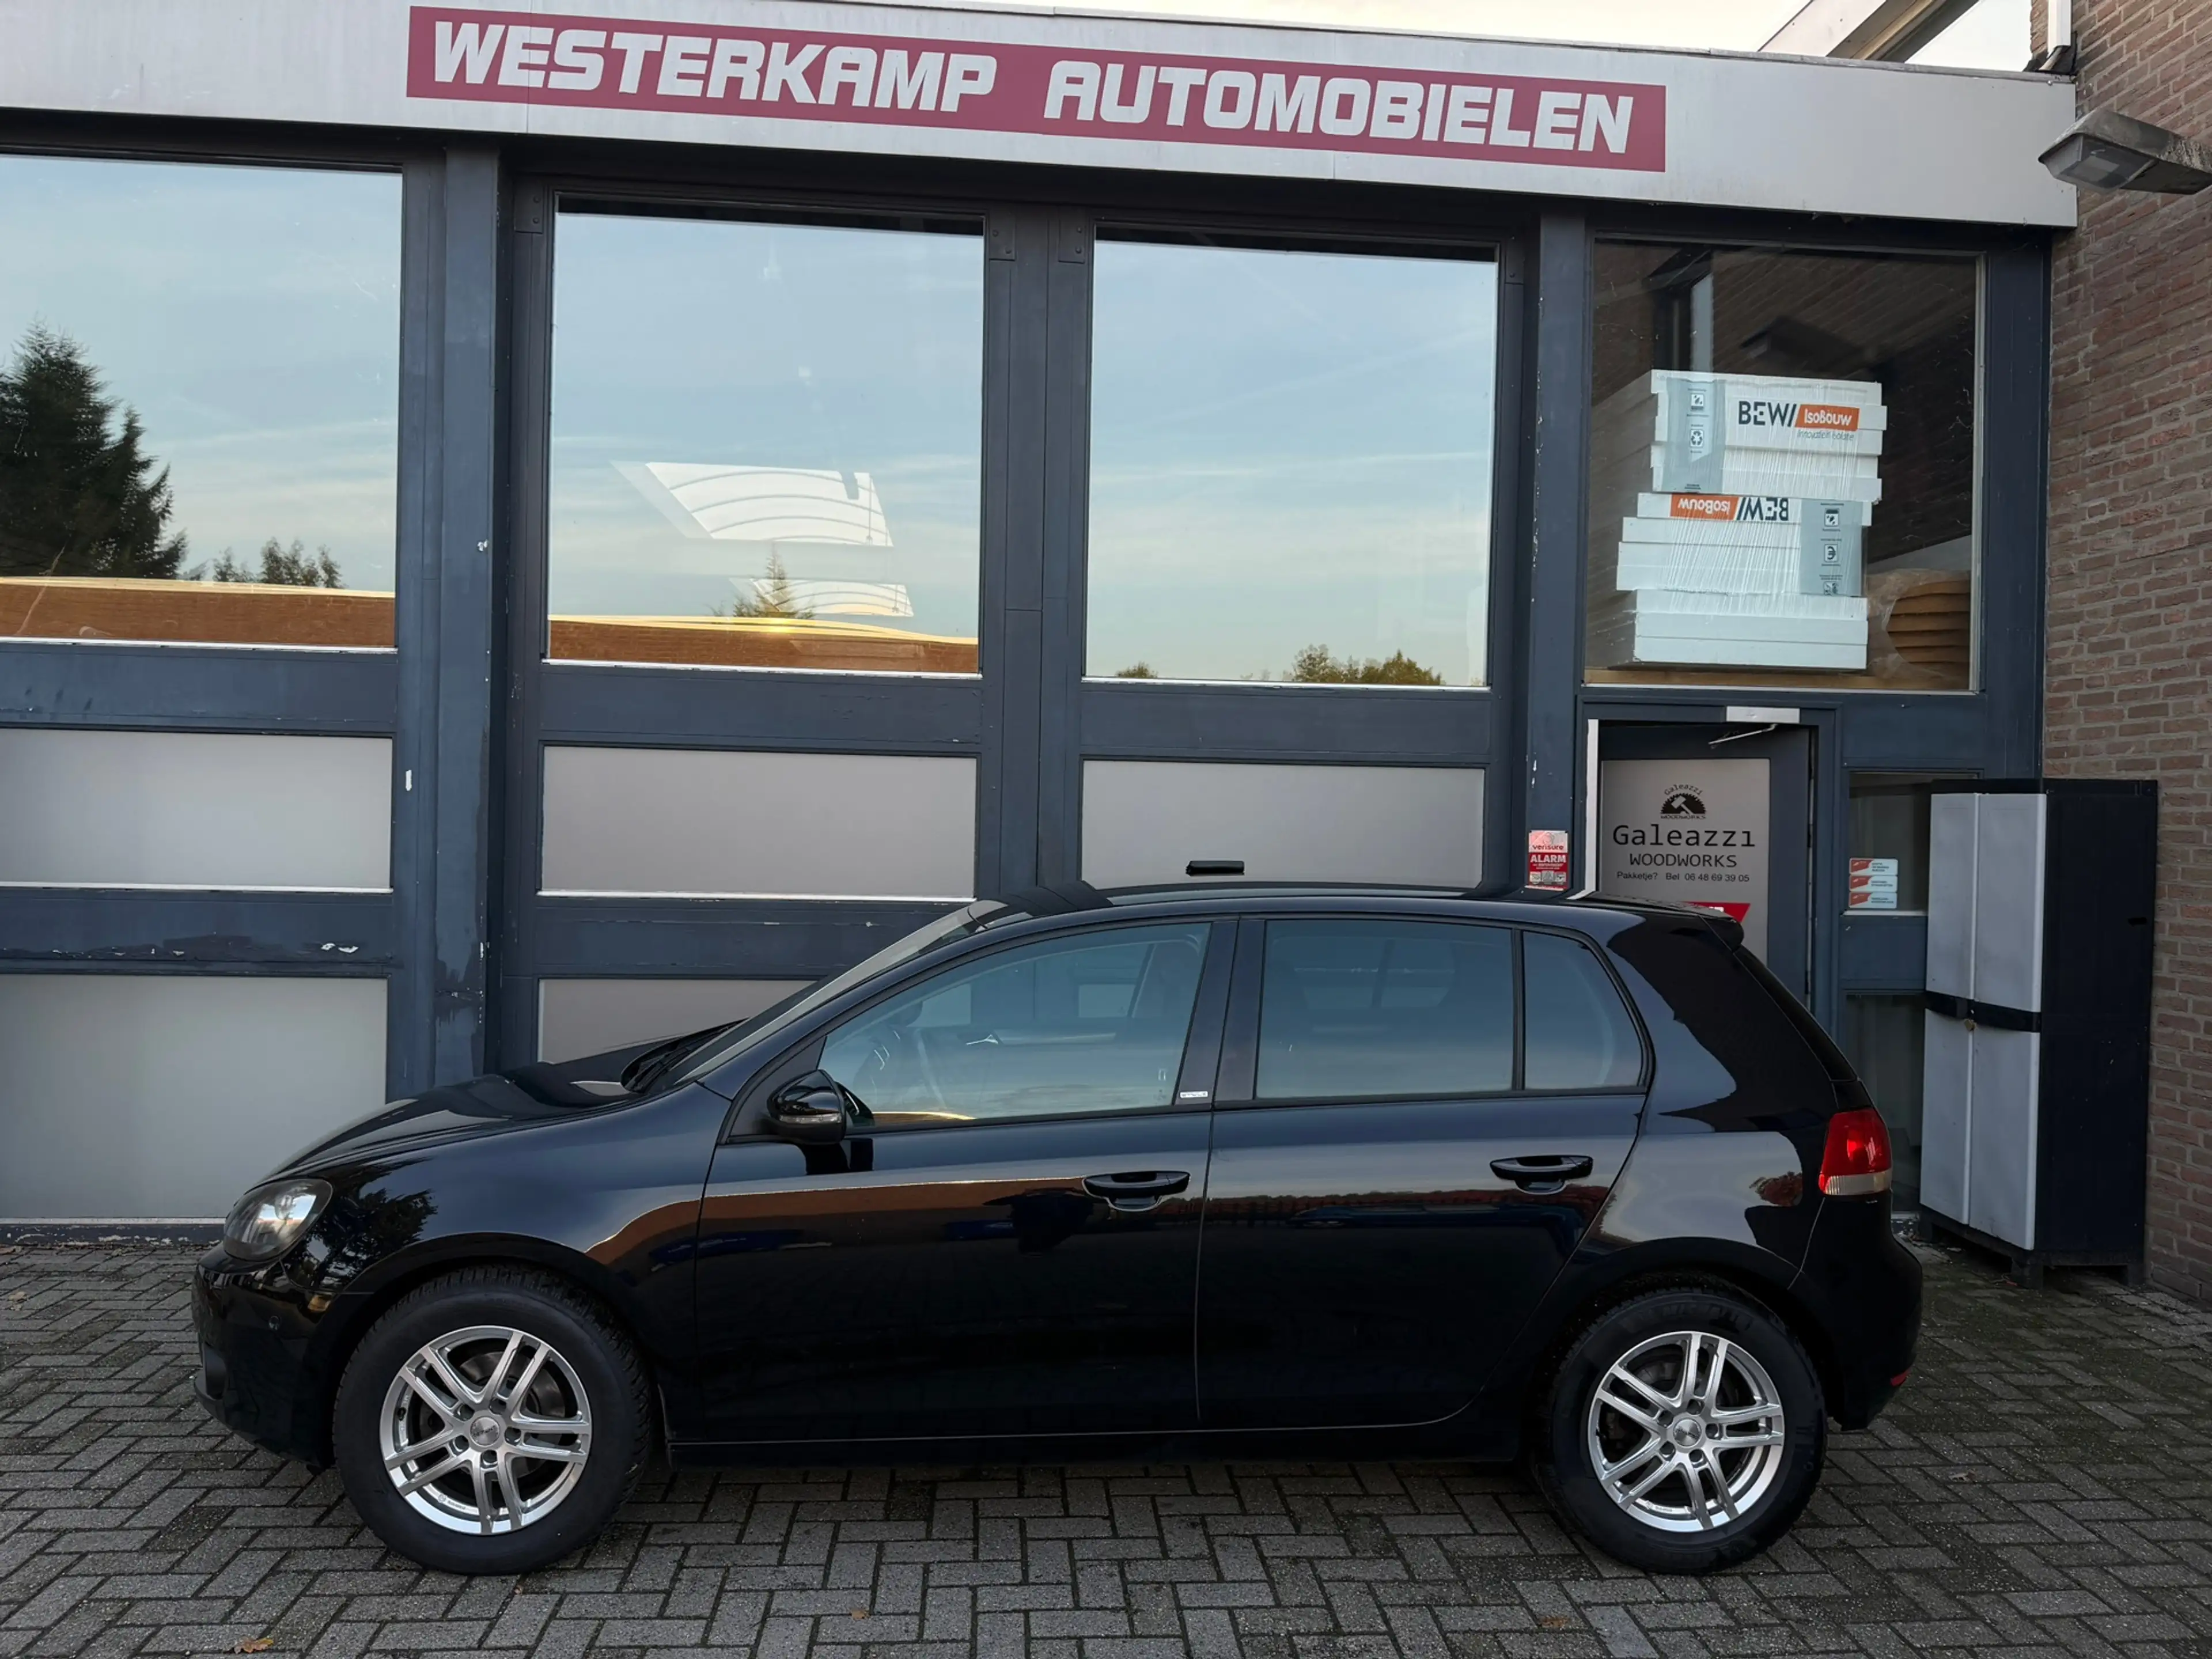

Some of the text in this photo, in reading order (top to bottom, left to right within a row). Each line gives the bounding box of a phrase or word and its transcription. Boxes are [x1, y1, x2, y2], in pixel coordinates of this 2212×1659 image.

[434, 21, 1634, 154] WESTERKAMP AUTOMOBIELEN
[1530, 854, 1566, 863] ALARM
[1630, 853, 1737, 868] WOODWORKS
[1616, 871, 1749, 882] Pakketje? Bel 06 48 69 39 05
